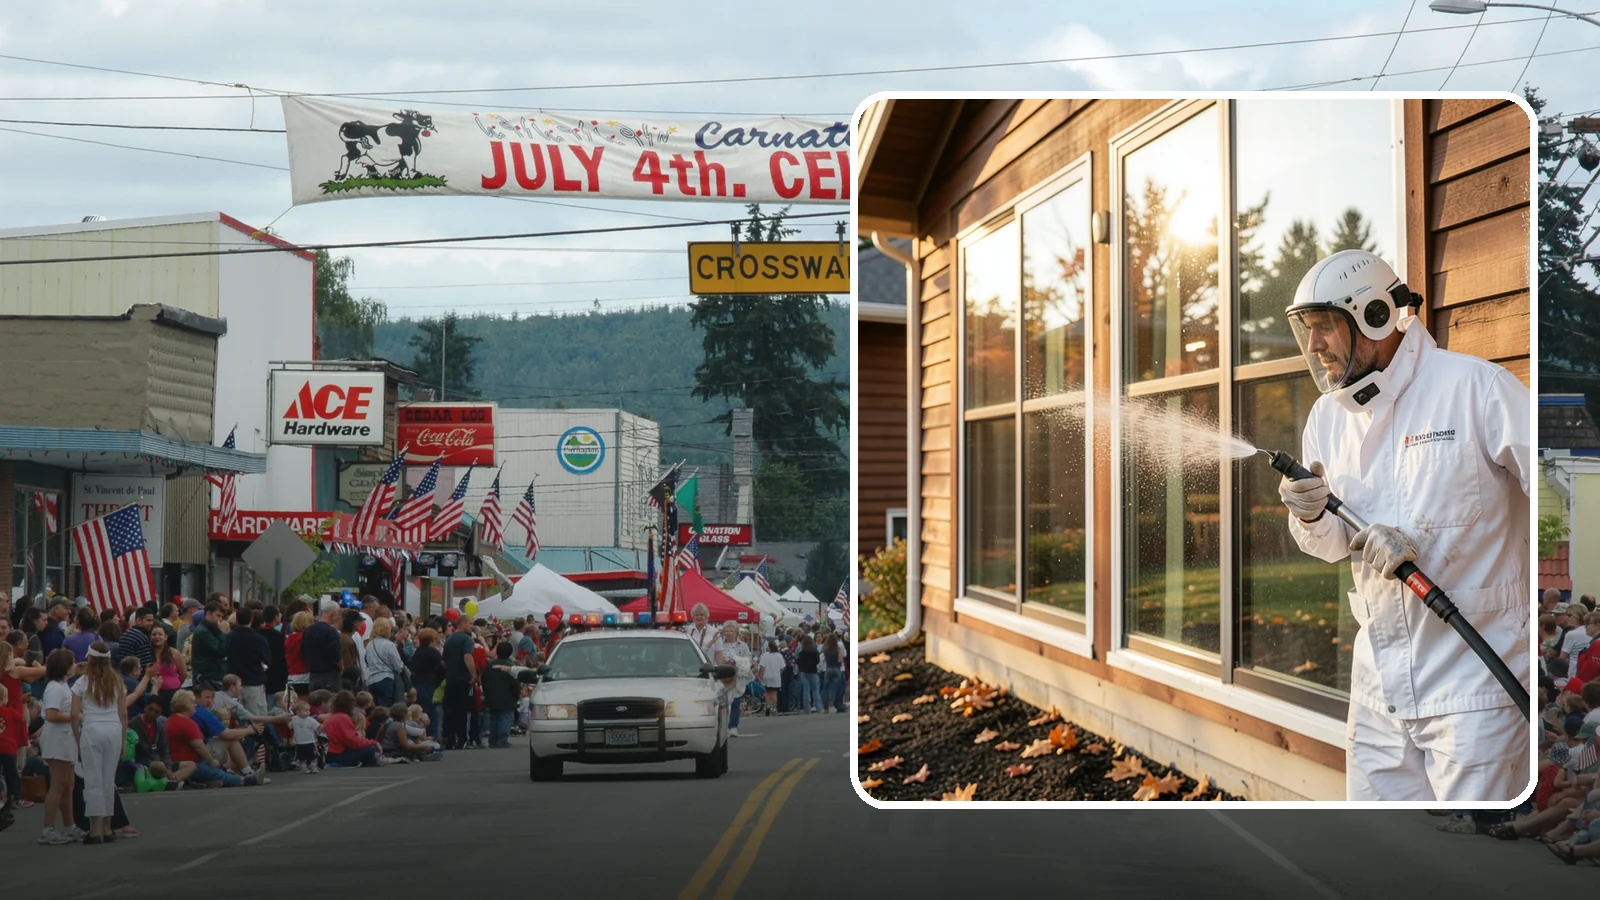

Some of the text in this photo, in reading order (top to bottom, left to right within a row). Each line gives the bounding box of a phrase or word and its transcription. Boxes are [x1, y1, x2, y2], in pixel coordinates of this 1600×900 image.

[481, 141, 605, 193] JULY
[632, 150, 747, 198] 4th.
[697, 254, 850, 280] CROSSWA
[282, 380, 374, 420] ACE
[406, 409, 486, 422] CEDAR LOG
[283, 421, 371, 437] Hardware
[416, 428, 477, 447] Coca-Cola
[353, 467, 384, 480] Simpl
[96, 485, 124, 495] Vincent
[126, 486, 136, 495] de
[137, 486, 155, 495] Paul
[212, 516, 331, 535] HARDARE
[688, 526, 741, 535] CRNATION
[699, 535, 730, 543] GLASS
